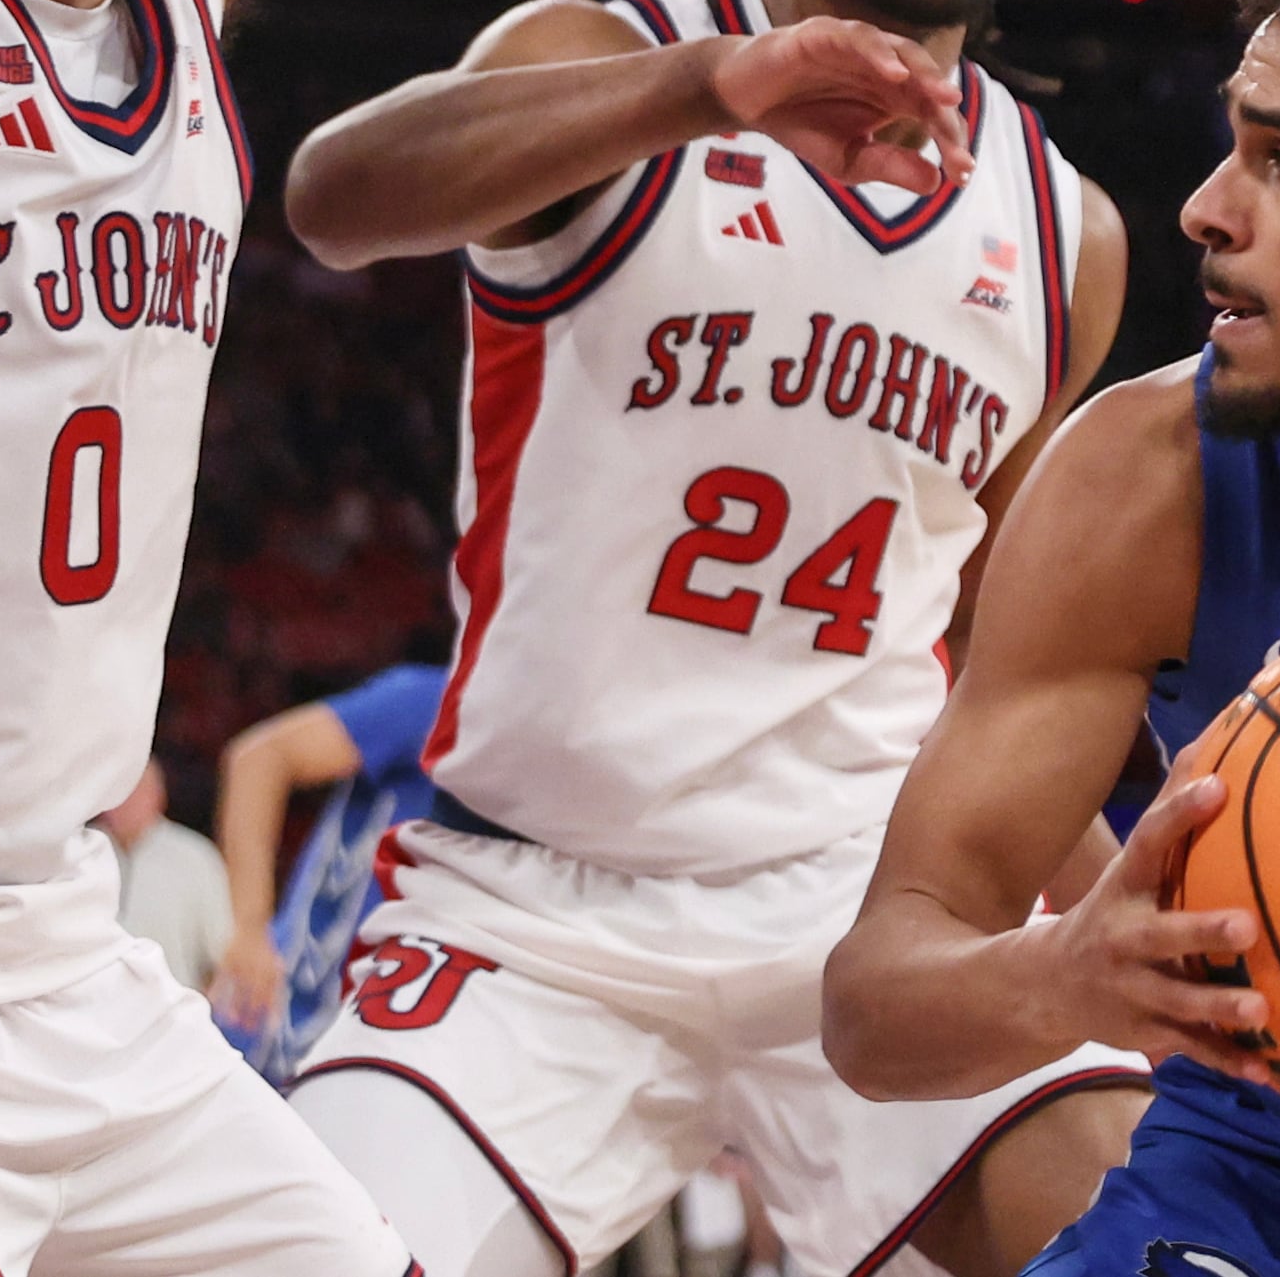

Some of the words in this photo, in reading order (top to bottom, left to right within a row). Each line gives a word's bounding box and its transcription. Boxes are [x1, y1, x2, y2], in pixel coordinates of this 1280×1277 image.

[34, 211, 228, 350] JOHN'S
[624, 311, 756, 413] ST.
[770, 312, 1010, 492] JOHN'S
[39, 404, 122, 606] 0
[646, 465, 901, 658] 24
